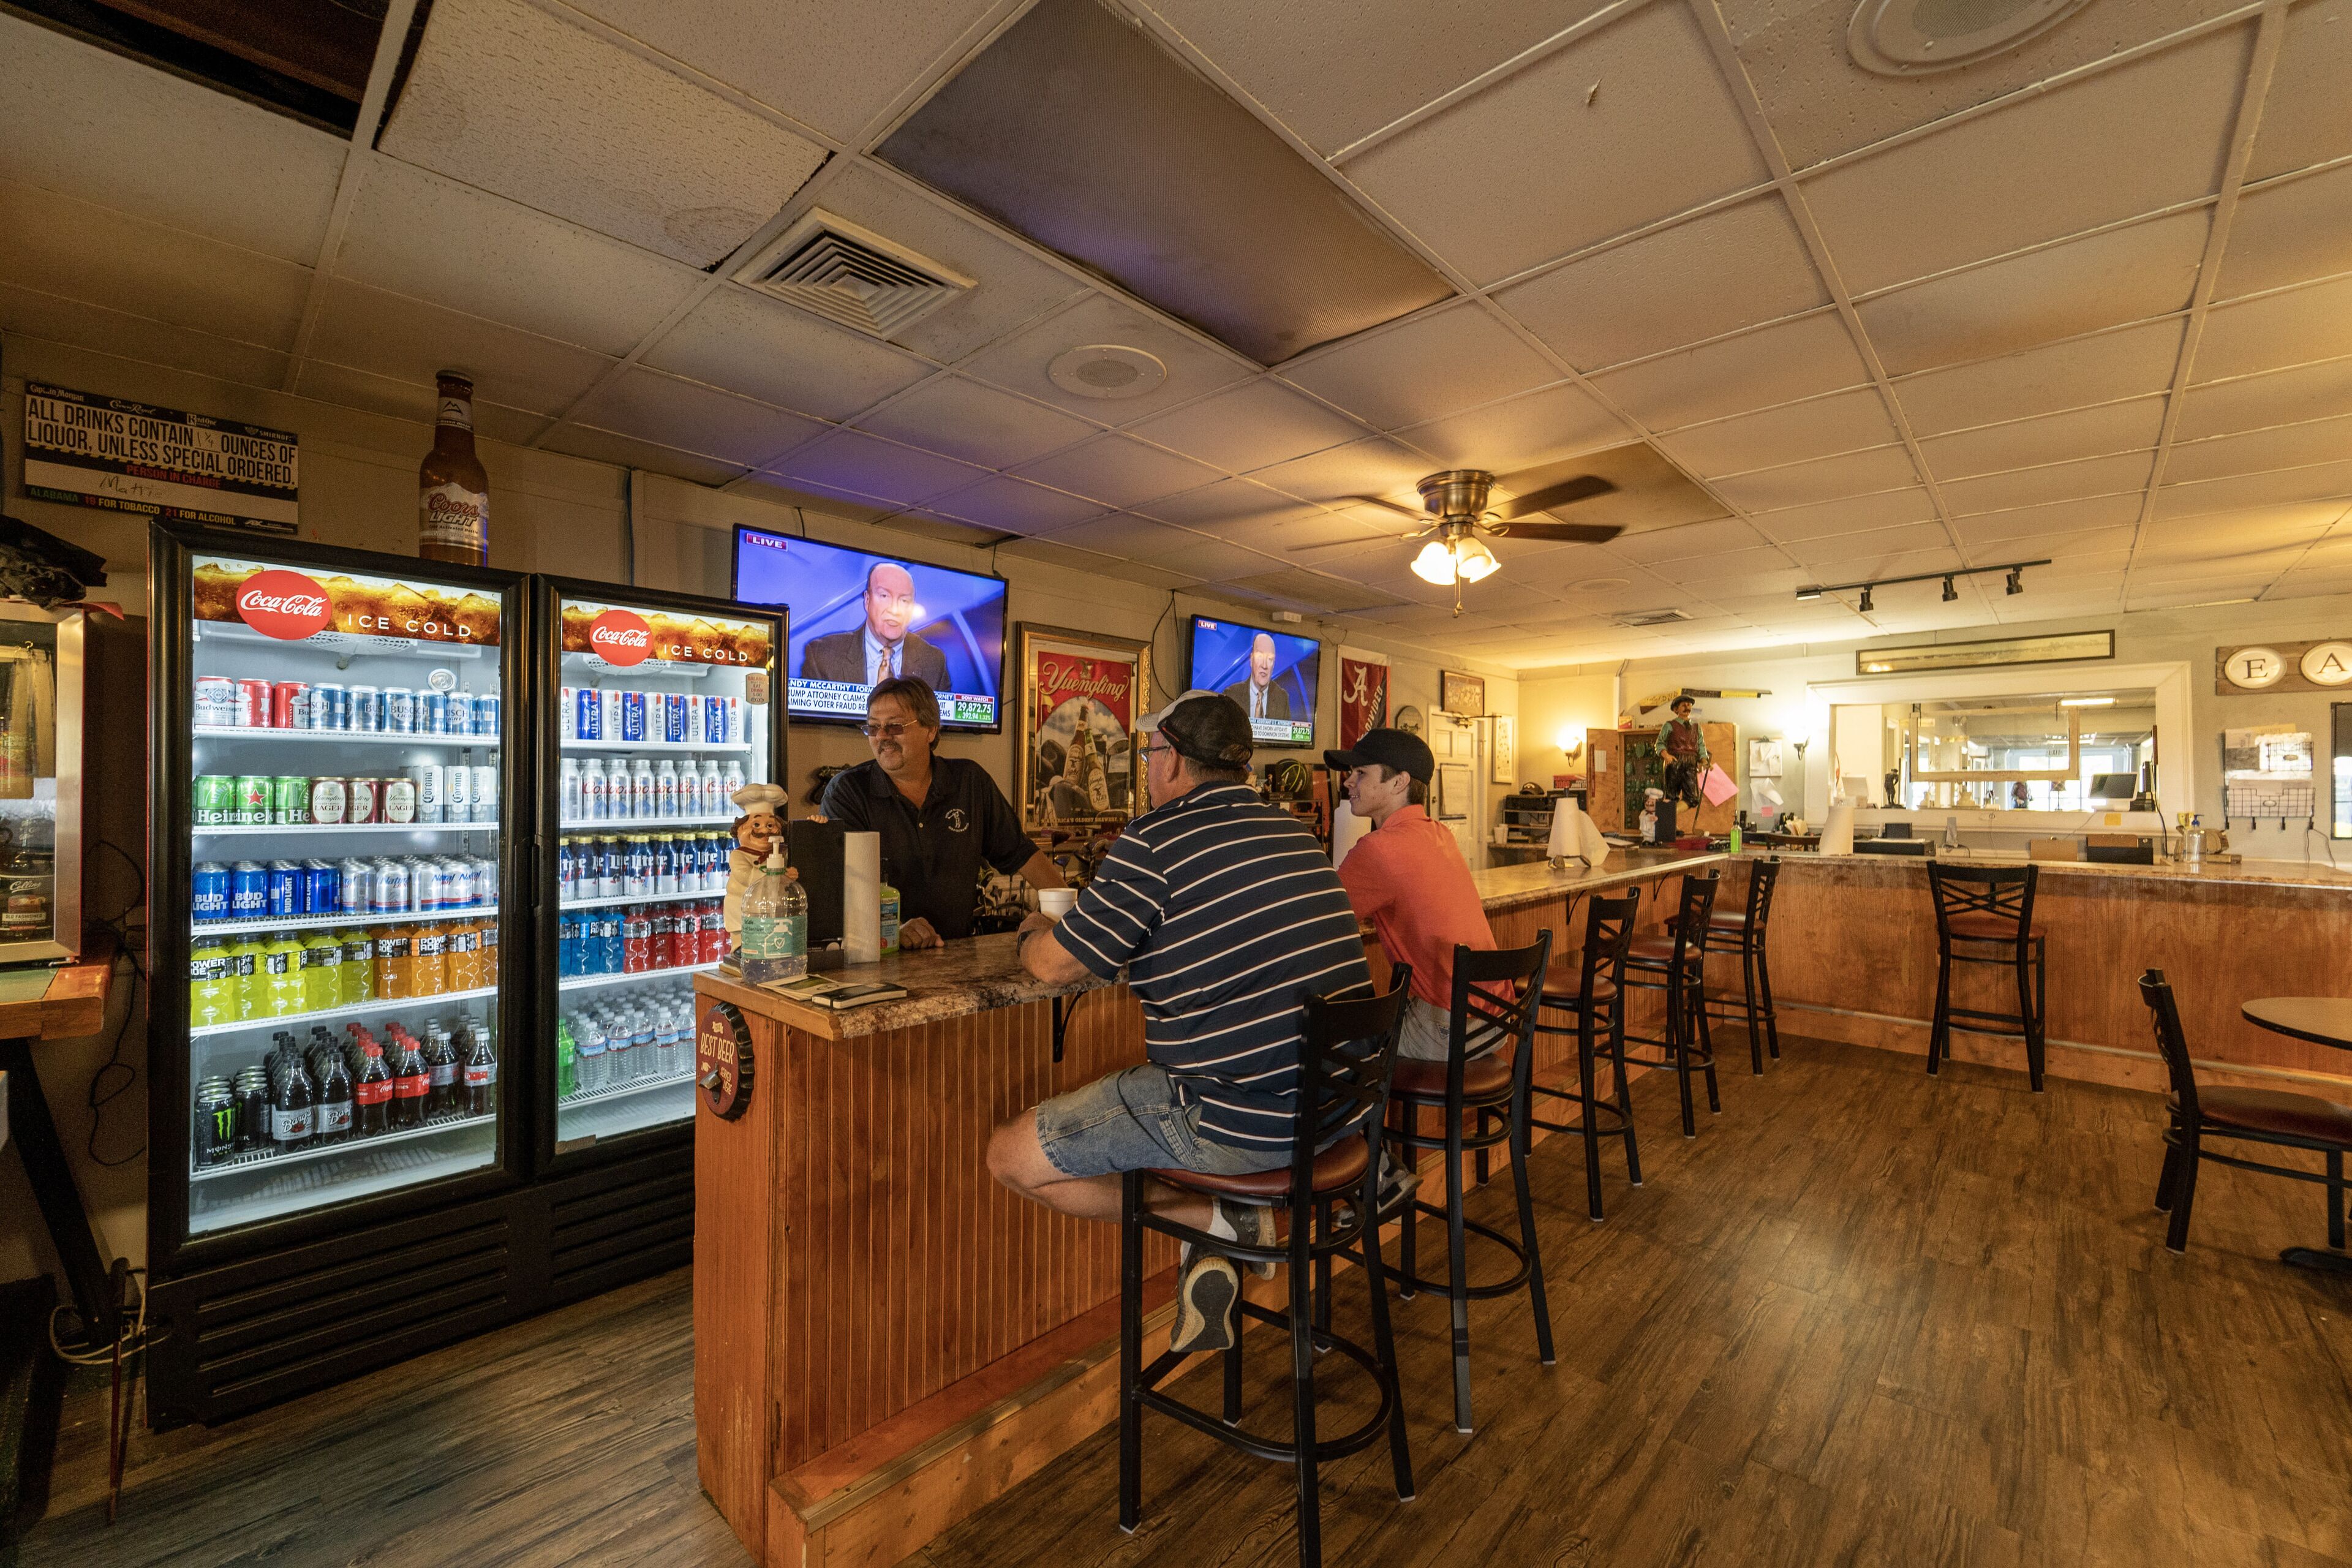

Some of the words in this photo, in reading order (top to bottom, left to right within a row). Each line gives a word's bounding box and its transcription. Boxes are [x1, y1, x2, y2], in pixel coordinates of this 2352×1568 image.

[56, 390, 84, 401] Morgan
[28, 399, 59, 423] ALL
[64, 404, 124, 434] DRINKS
[129, 417, 194, 447] CONTAIN
[28, 420, 92, 452] LIQUOR,
[98, 433, 158, 462] UNLESS
[163, 445, 224, 473] SPECIAL
[227, 456, 295, 485] ORDERED.
[221, 435, 276, 461] OUNCES
[279, 445, 296, 464] OF
[127, 465, 167, 480] PERSON
[170, 472, 179, 483] IN
[182, 474, 221, 489] CHARGE
[31, 488, 78, 503] ALABAMA
[99, 498, 117, 508] FOR
[119, 500, 160, 514] TOBACCO
[165, 508, 177, 518] 21
[179, 510, 196, 519] FOR
[198, 513, 235, 525] ALCOHOL
[428, 492, 480, 518] Coors
[429, 511, 478, 527] LIGHT
[752, 536, 783, 549] LIVE
[240, 590, 328, 617] Coca-Cola
[348, 613, 390, 630] ICE
[405, 620, 471, 638] COLD
[592, 626, 650, 647] Coca-Cola
[664, 644, 692, 657] ICE
[703, 648, 748, 662] COLD
[809, 682, 850, 692] MCCARTHY
[1039, 660, 1130, 703] Yuengling
[1343, 665, 1368, 707] A
[788, 689, 805, 698] RUMP
[807, 691, 842, 700] ATTORNEY
[843, 694, 865, 703] CLAIMS
[788, 698, 812, 707] AIMING
[813, 700, 834, 709] VOTER
[836, 702, 857, 710] FRAUD
[311, 701, 330, 710] SCH
[390, 705, 414, 714] BUSC
[957, 702, 992, 713] 29,872.75
[423, 772, 434, 804] Corona
[452, 772, 464, 804] Corona
[471, 772, 480, 803] Corona
[195, 893, 224, 903] BUD
[232, 899, 267, 909] LIGHT
[235, 892, 263, 901] BUD
[193, 901, 228, 911] LIGHT
[379, 938, 409, 947] POWER
[192, 958, 226, 968] OWER
[700, 1032, 718, 1058] BEST
[717, 1038, 734, 1065] BEER
[720, 1066, 732, 1082] SERVED
[723, 1079, 733, 1095] HERE
[282, 1107, 312, 1134] Barq's
